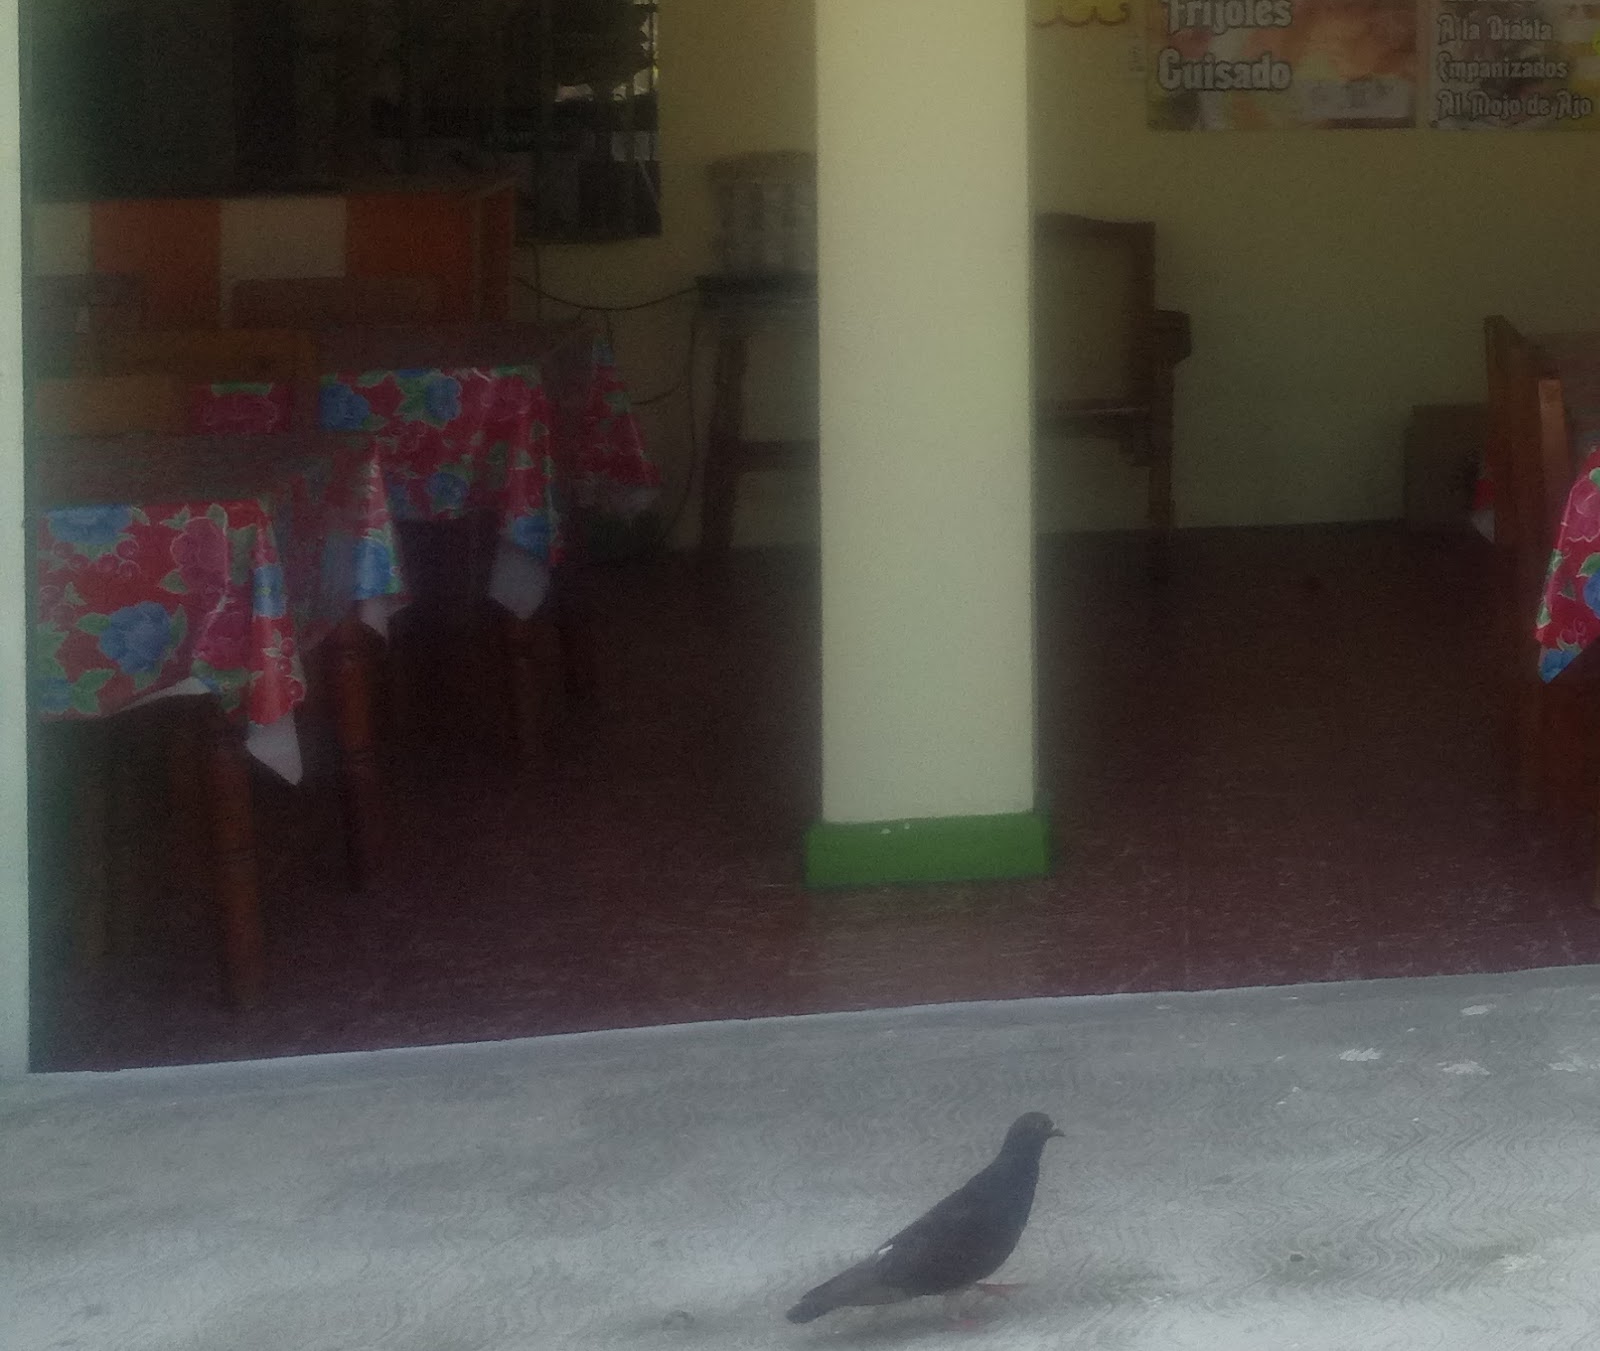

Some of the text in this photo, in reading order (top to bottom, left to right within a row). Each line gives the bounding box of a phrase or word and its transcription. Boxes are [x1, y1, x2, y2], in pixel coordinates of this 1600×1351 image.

[1488, 15, 1553, 43] Diabla
[1158, 48, 1293, 91] Guisado
[1439, 50, 1569, 82] Empanizados
[1437, 88, 1593, 121] Al Mojo de Ajo
